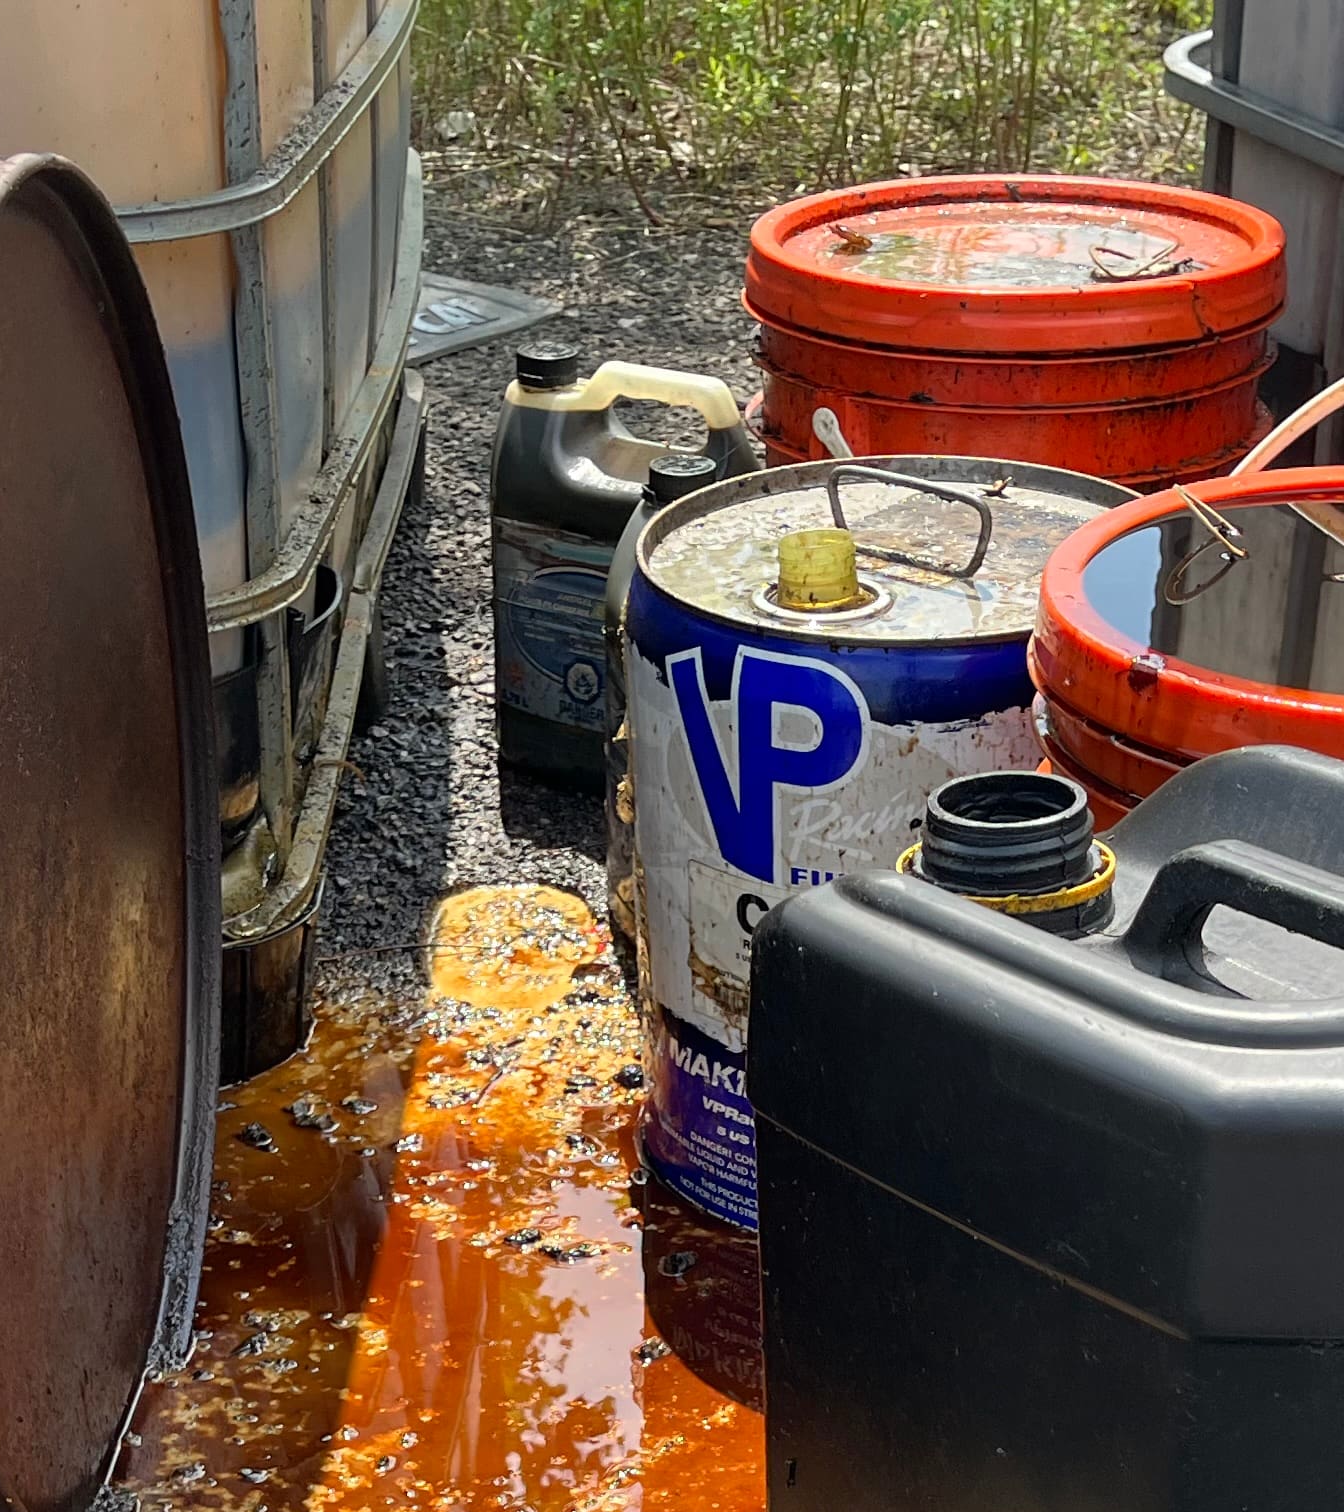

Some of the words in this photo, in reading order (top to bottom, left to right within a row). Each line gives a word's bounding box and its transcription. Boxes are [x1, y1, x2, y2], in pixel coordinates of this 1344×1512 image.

[665, 645, 870, 884] VP
[789, 790, 928, 862] Racin
[696, 1146, 726, 1167] LIQUID
[727, 1161, 749, 1176] AND
[729, 1130, 750, 1146] US
